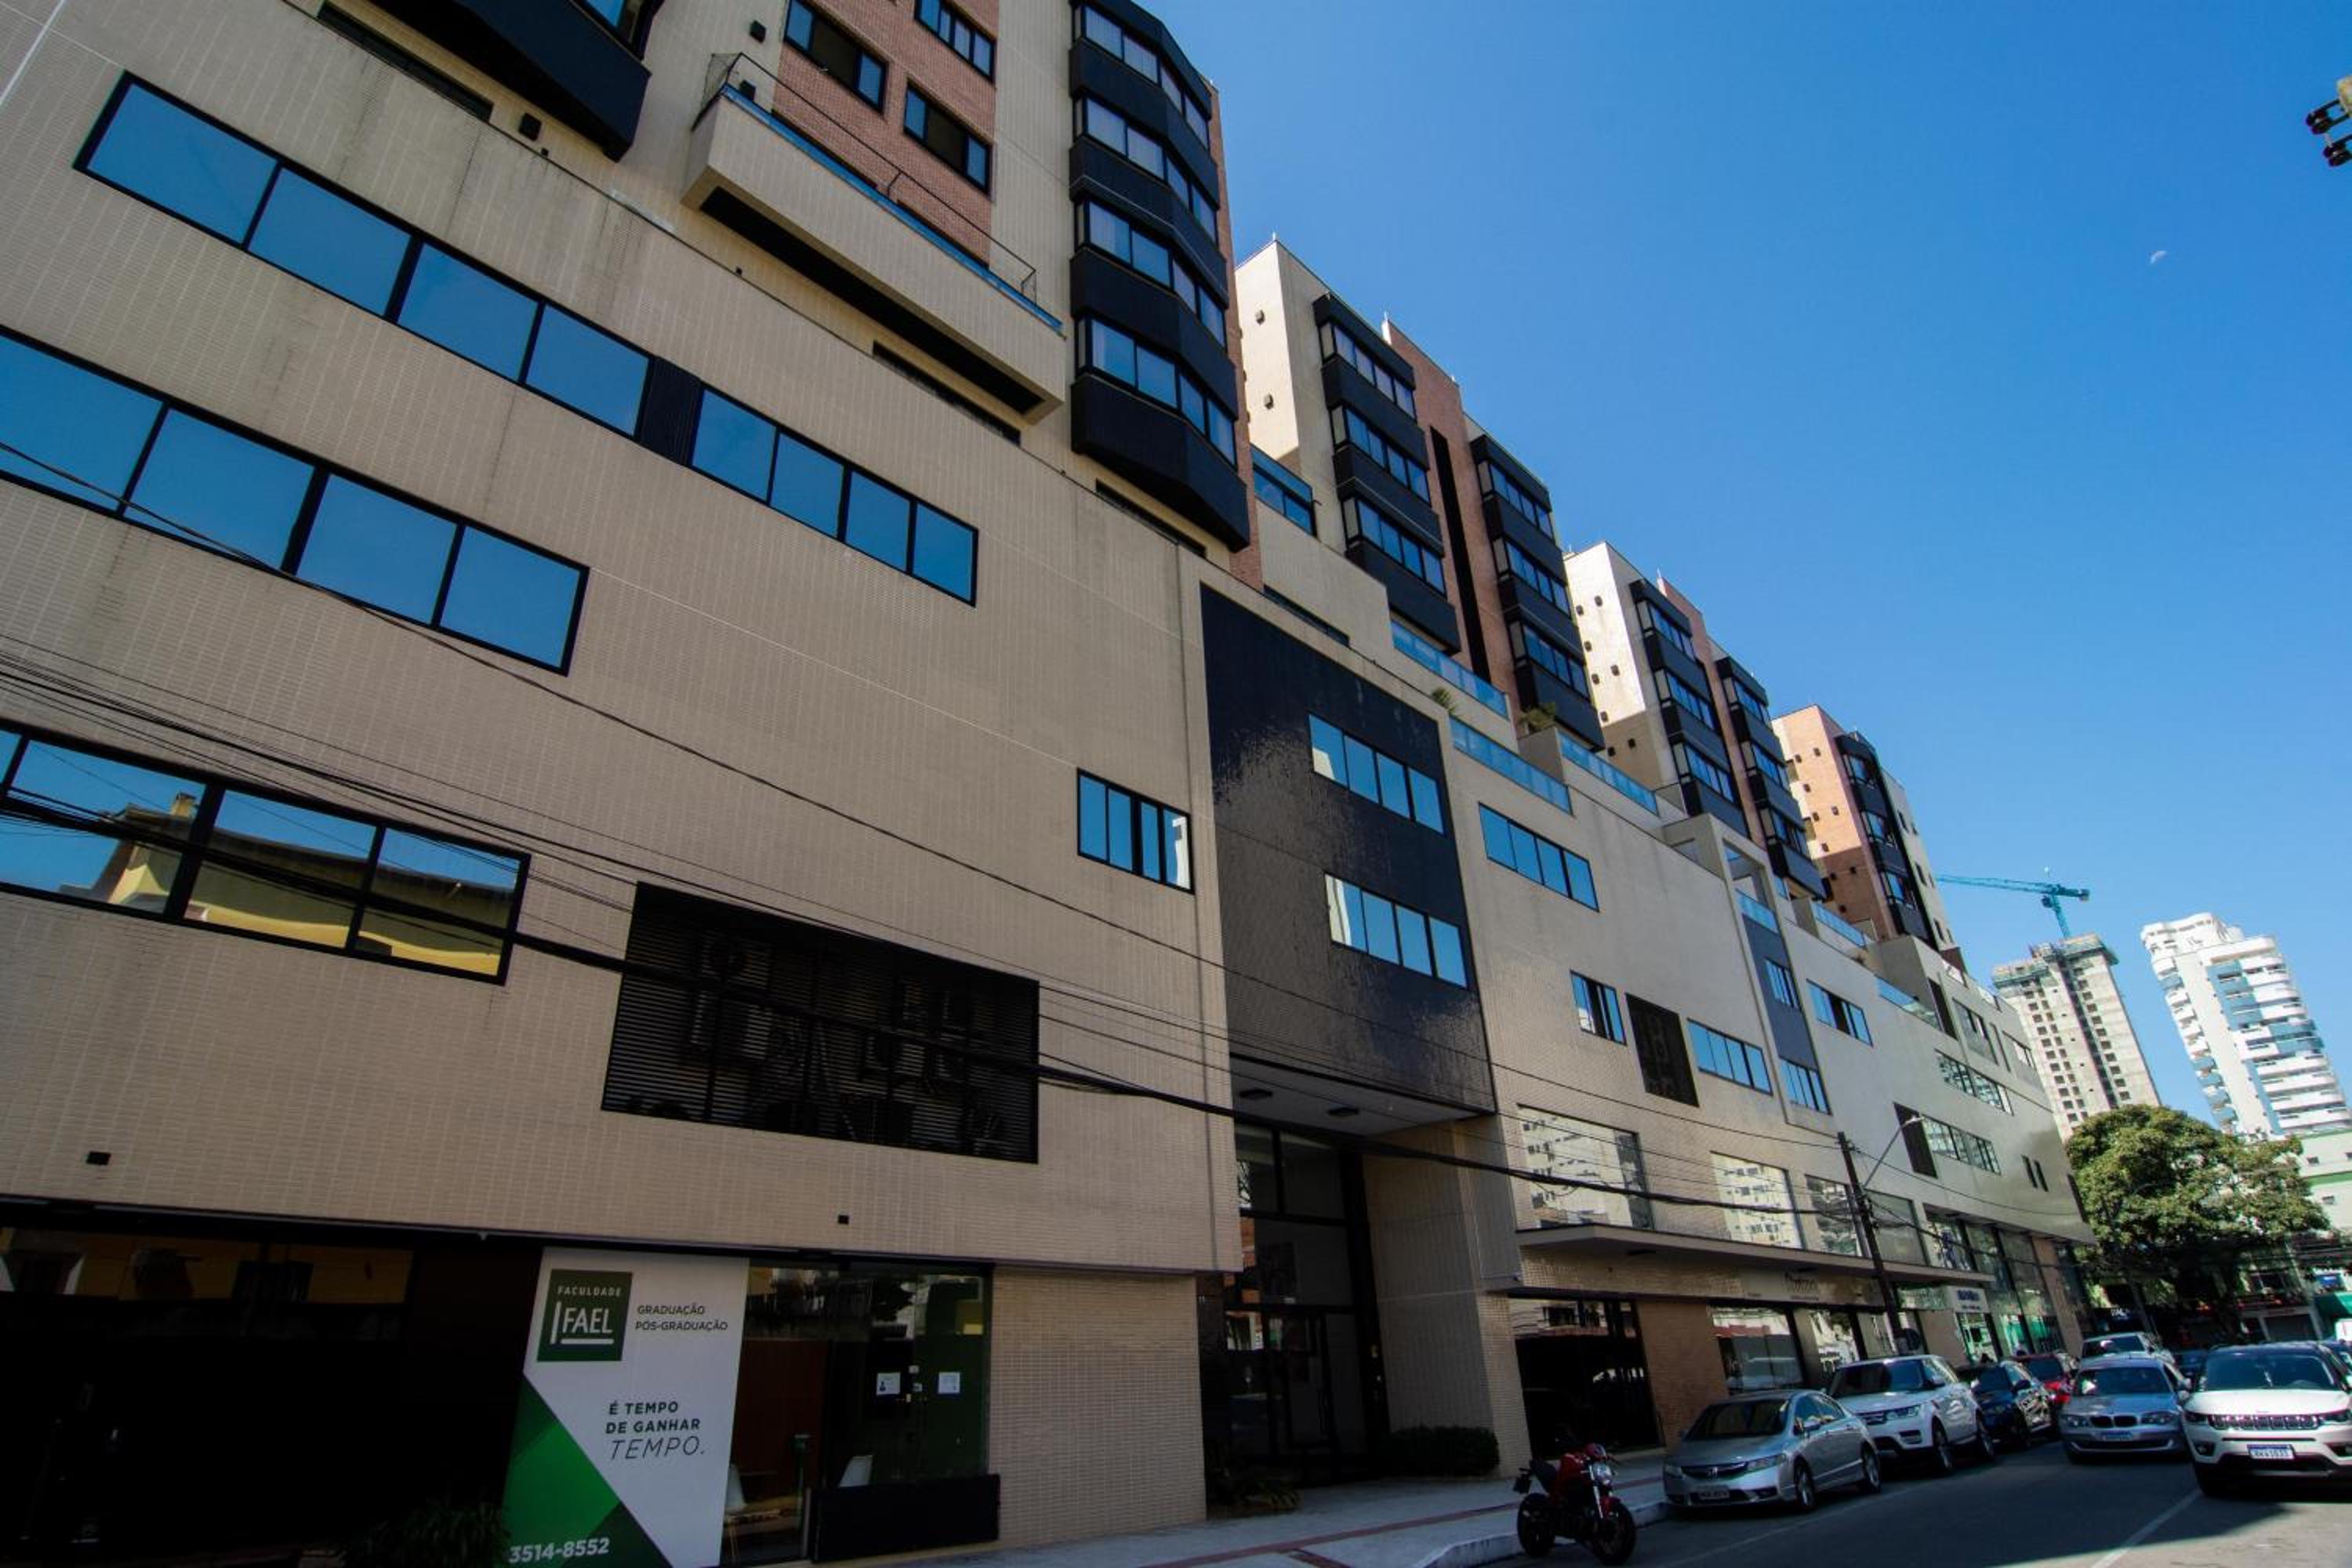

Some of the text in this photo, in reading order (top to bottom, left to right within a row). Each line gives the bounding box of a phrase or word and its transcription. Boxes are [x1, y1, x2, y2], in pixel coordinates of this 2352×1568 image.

[557, 1286, 621, 1297] FACULDADE
[637, 1303, 705, 1316] GRADUAÇÃO
[561, 1307, 614, 1334] FAEL
[608, 1400, 678, 1415] É TEMPO
[605, 1418, 700, 1434] DE GANHAR
[610, 1436, 705, 1460] TEMPO.
[509, 1537, 609, 1563] 3514-8552
